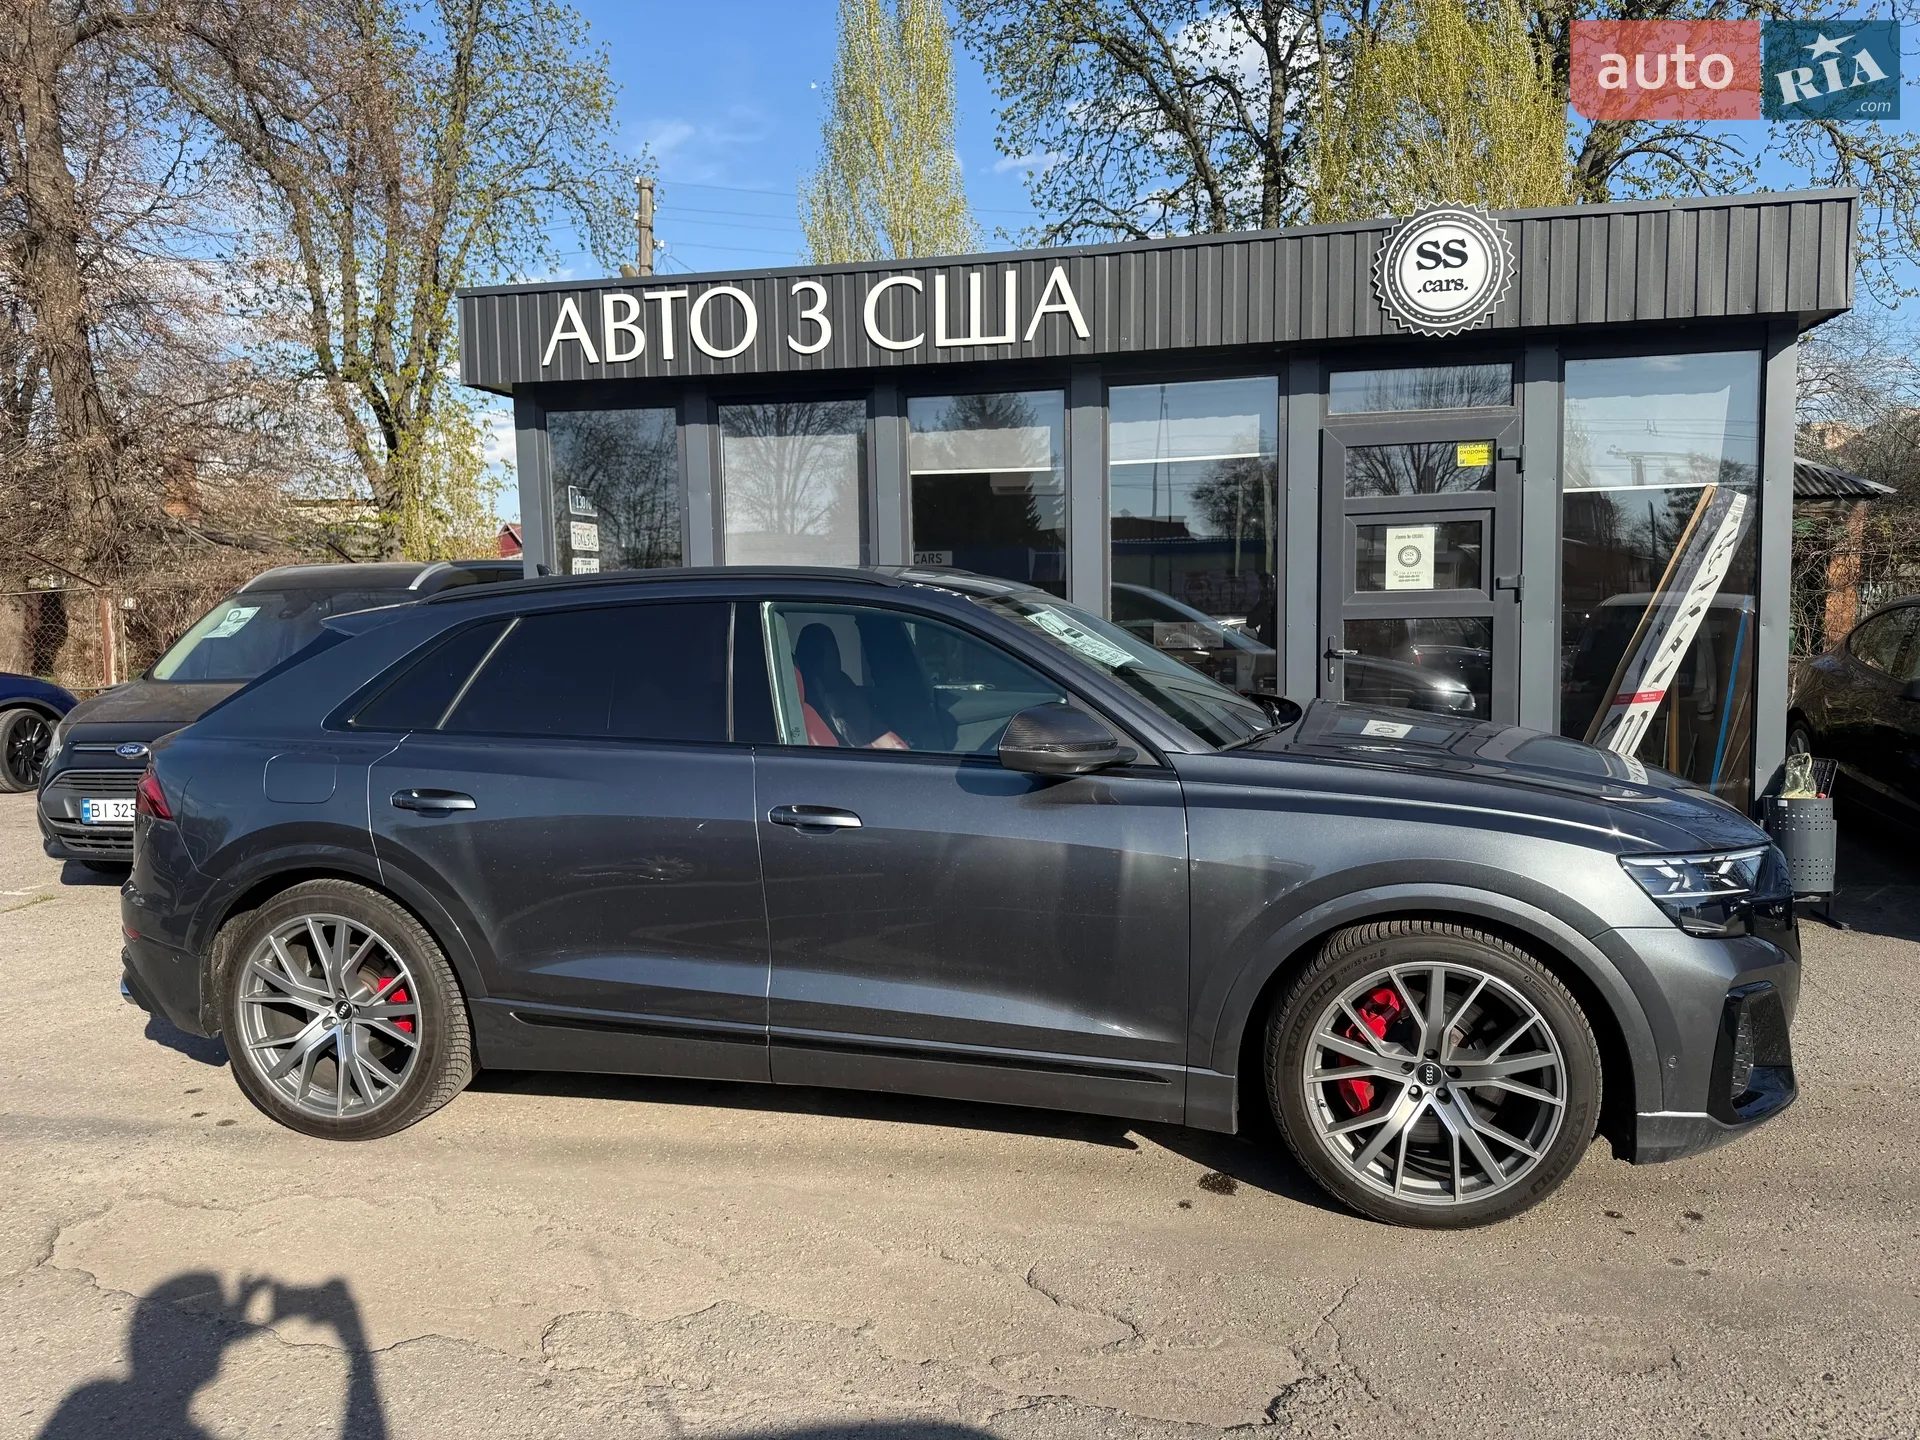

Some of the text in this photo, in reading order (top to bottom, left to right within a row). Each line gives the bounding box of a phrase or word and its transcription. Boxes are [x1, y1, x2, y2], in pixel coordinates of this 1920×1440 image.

[1415, 238, 1469, 271] SS
[541, 286, 758, 367] АВТО
[863, 265, 1091, 351] США
[914, 553, 942, 564] CARS
[121, 744, 139, 753] Ford
[91, 803, 107, 817] BI
[1290, 976, 1338, 1047] MICHELIN
